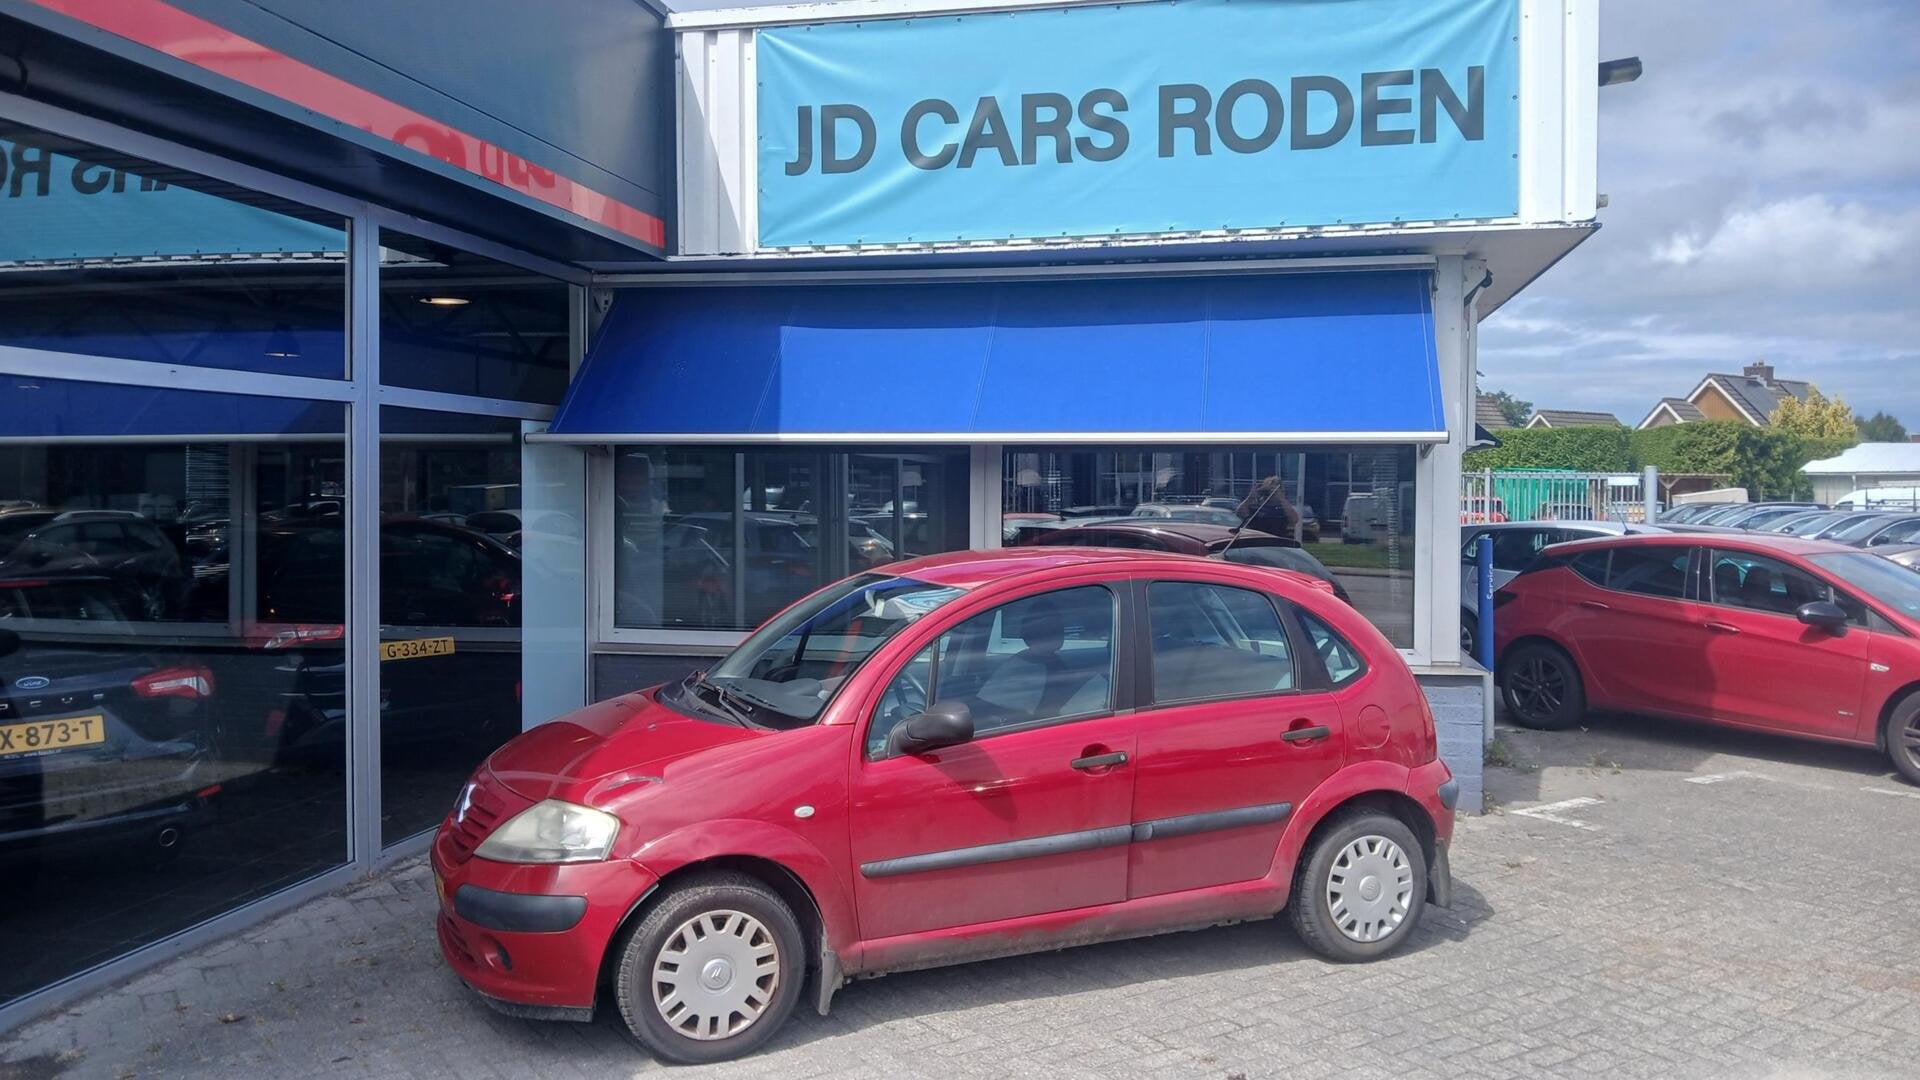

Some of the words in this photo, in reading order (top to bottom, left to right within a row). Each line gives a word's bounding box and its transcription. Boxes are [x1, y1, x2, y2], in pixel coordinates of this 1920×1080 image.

[785, 103, 876, 176] JD
[900, 88, 1129, 170] CARS
[1157, 65, 1485, 157] RODEN
[387, 639, 448, 658] G-334-ZT
